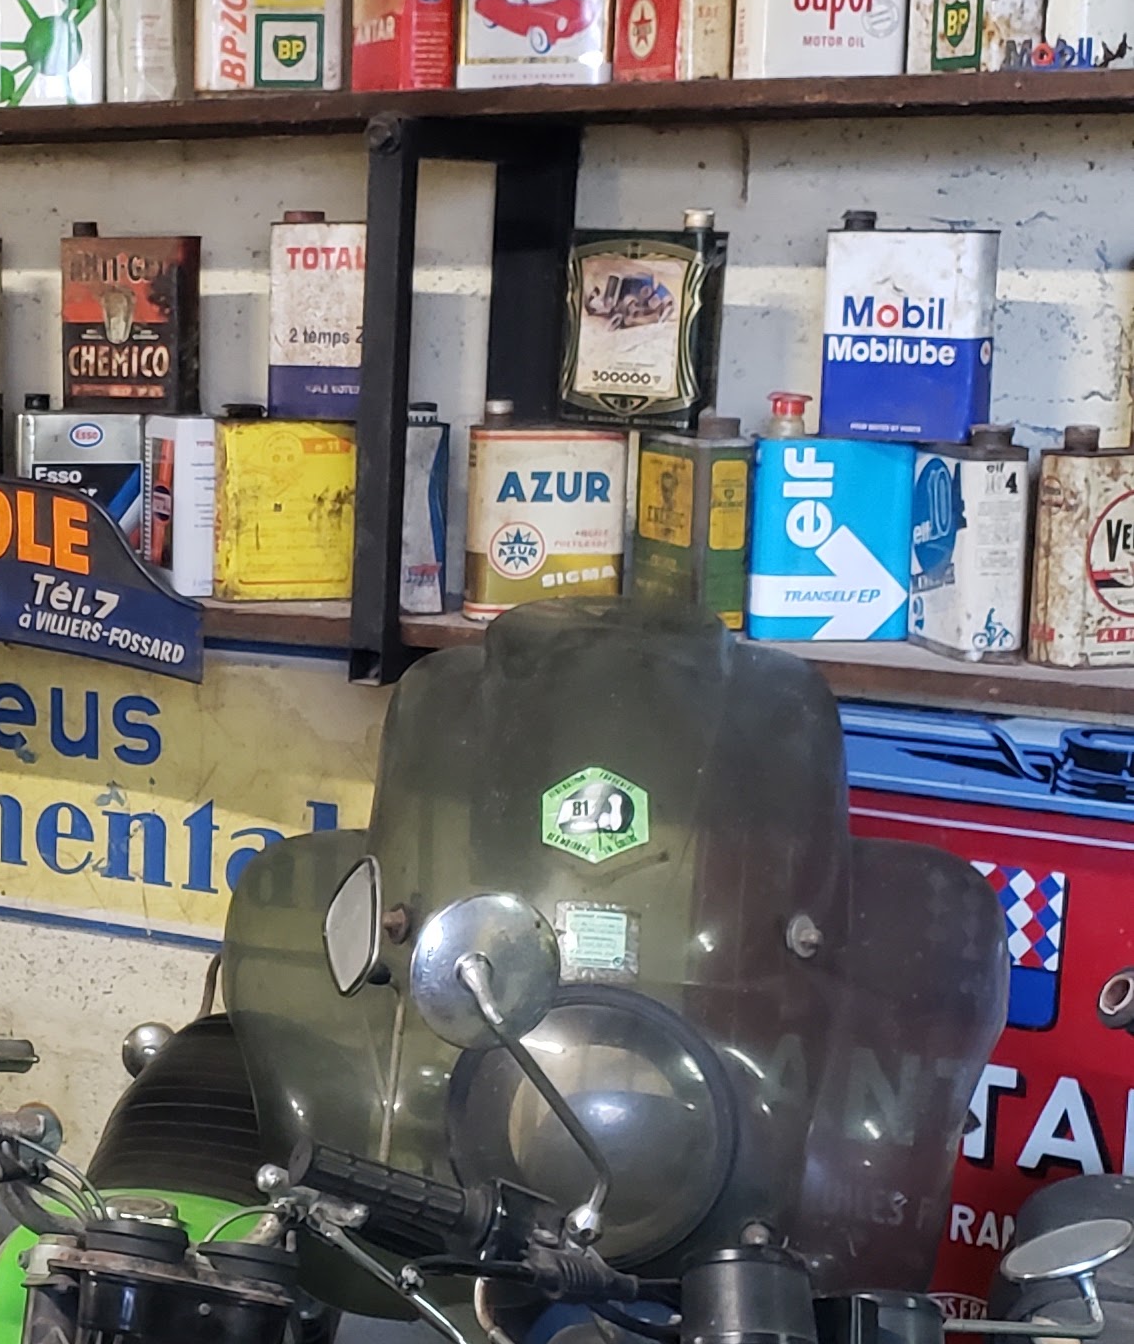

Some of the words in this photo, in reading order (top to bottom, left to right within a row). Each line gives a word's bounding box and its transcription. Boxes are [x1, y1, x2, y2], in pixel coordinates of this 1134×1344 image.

[947, 8, 969, 37] BP
[278, 40, 304, 60] BP
[802, 35, 843, 47] MOTOR
[848, 36, 865, 47] OIL
[286, 246, 365, 271] TOTAL
[842, 296, 945, 331] Mobil
[289, 327, 299, 344] 2
[302, 327, 350, 346] temps
[68, 345, 170, 377] CHEMICO
[827, 336, 956, 367] Mobilube
[496, 471, 612, 503] AZUR
[782, 447, 835, 548] elf
[497, 545, 539, 559] AZUR
[540, 564, 617, 588] SIGMA
[783, 590, 858, 604] TRANSELF
[856, 588, 881, 604] EP
[18, 606, 32, 629] à
[34, 611, 185, 665] VILLIERS-FOSSARD
[571, 799, 589, 817] 81
